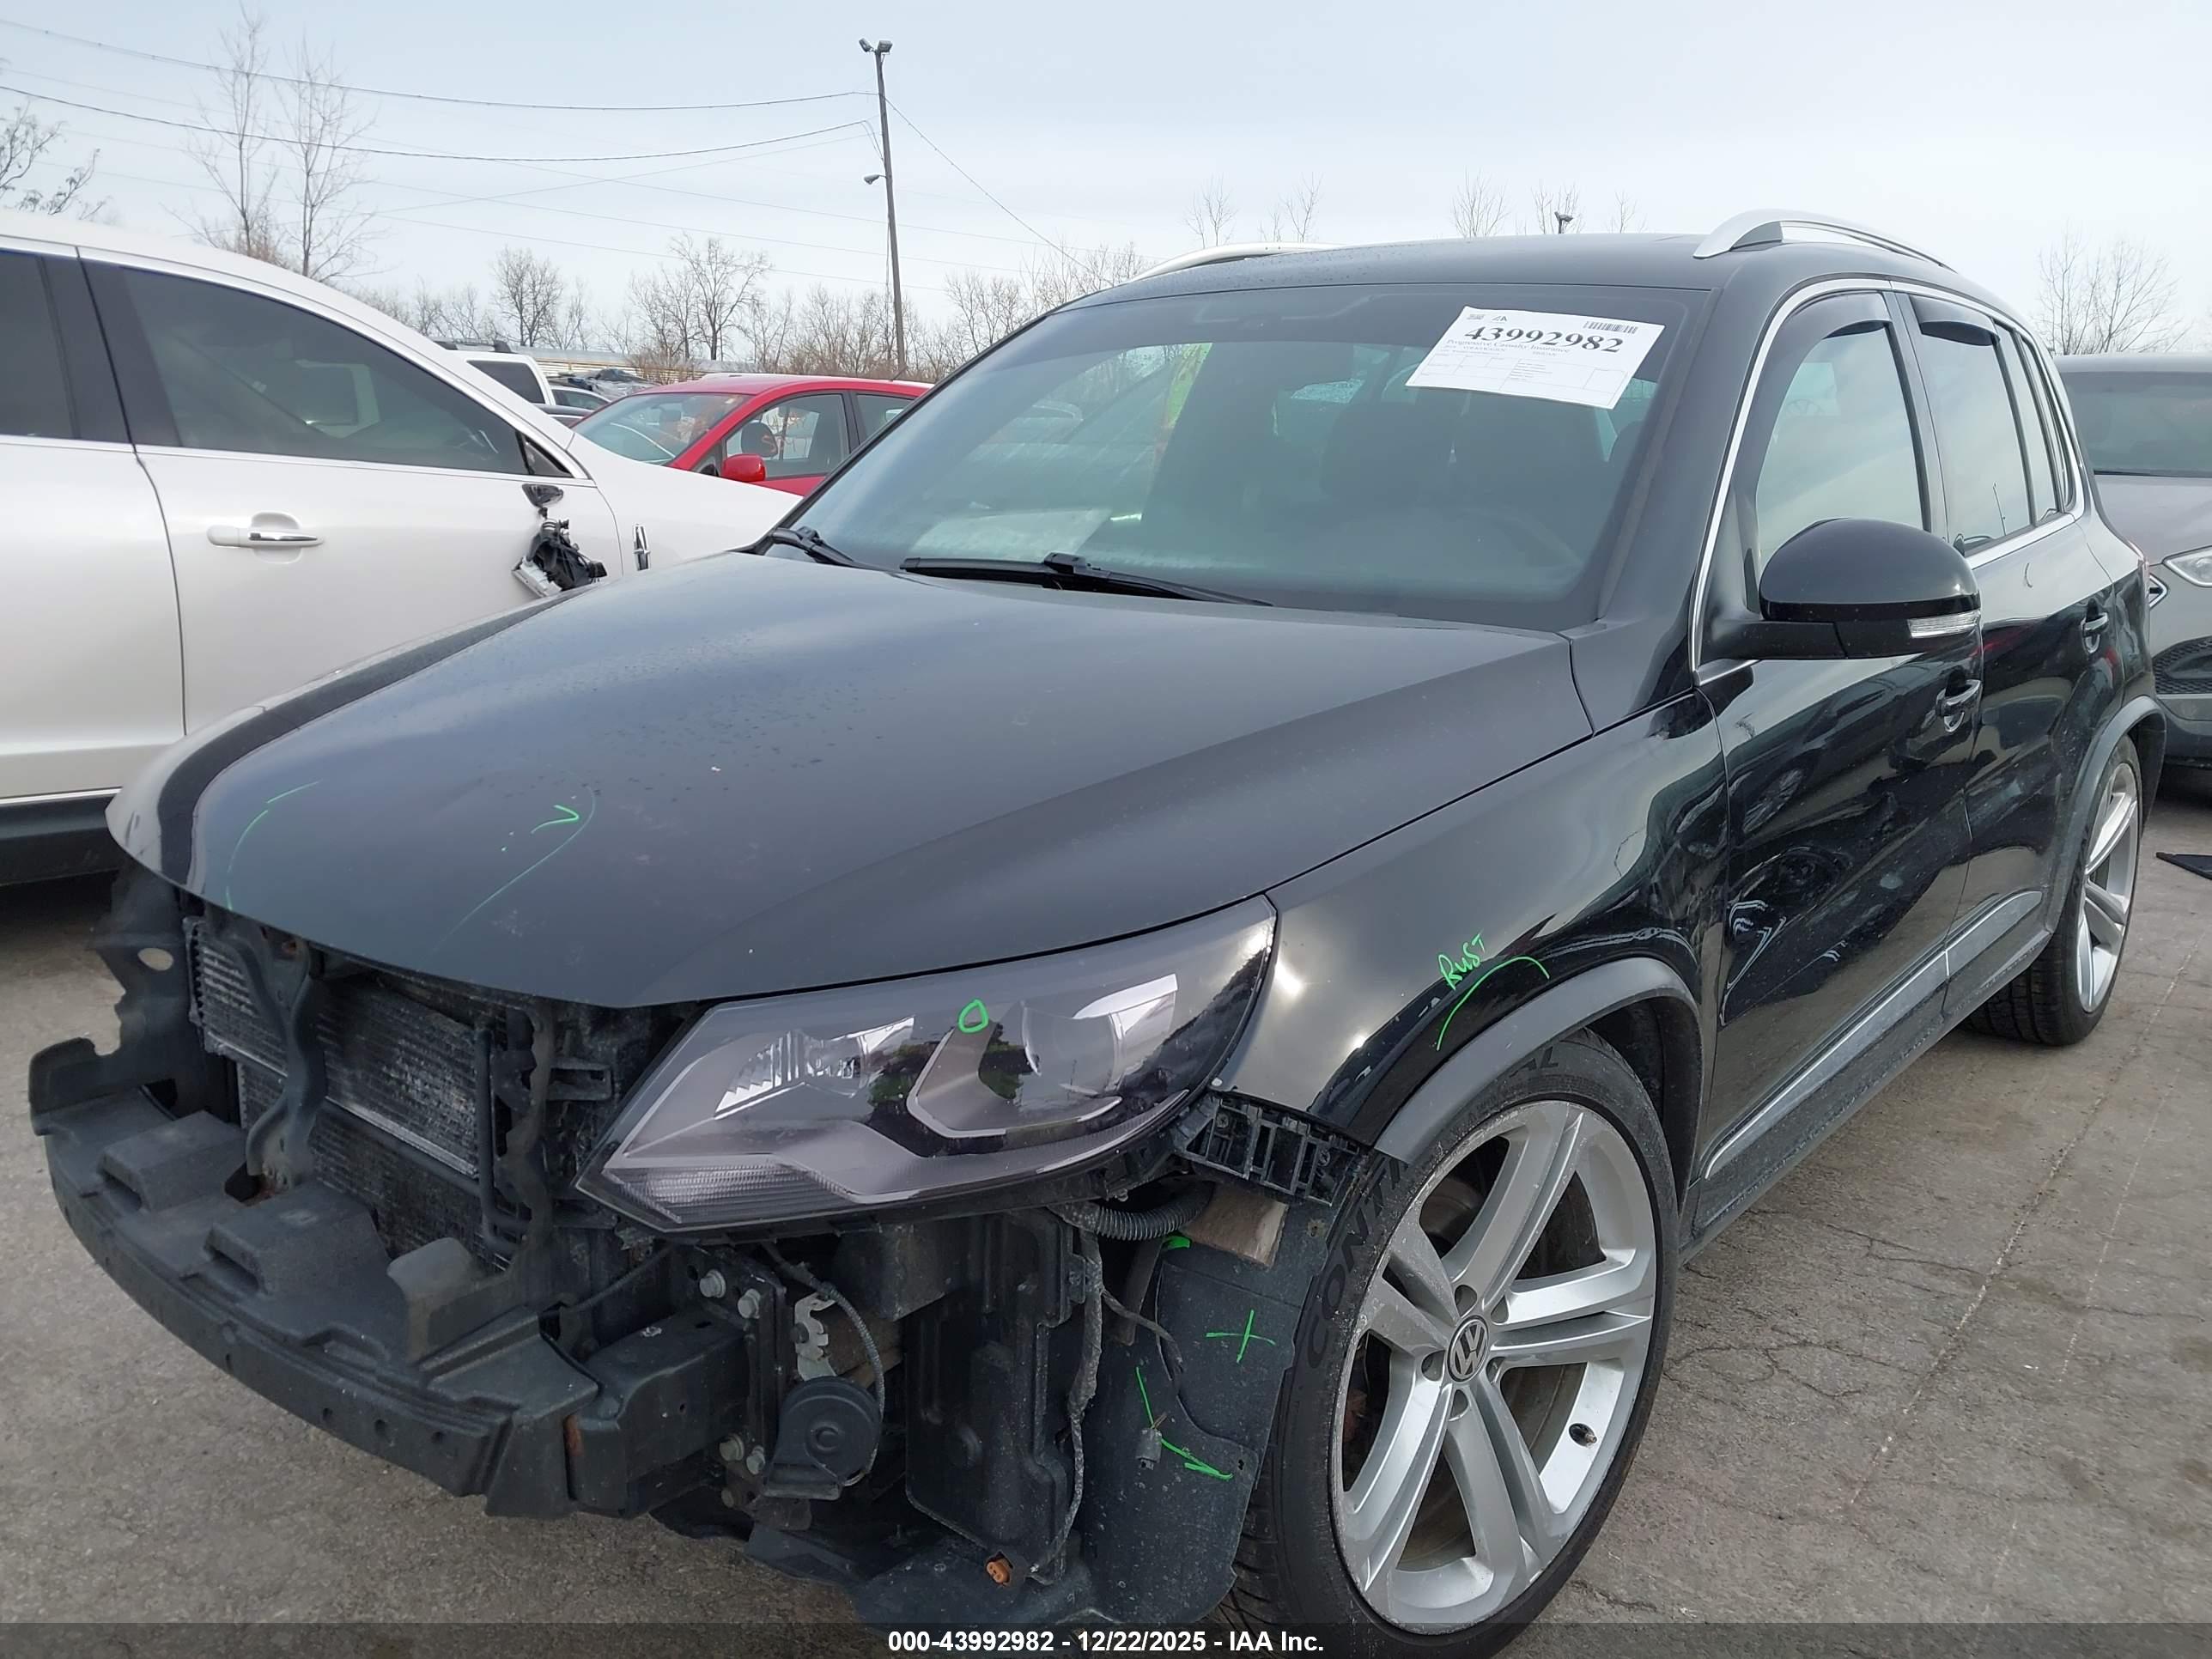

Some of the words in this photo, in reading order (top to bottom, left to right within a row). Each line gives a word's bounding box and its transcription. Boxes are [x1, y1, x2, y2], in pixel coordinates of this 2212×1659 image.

[1446, 338, 1493, 348] Progressive
[1529, 343, 1571, 353] Insurance
[1465, 325, 1624, 353] 43992982
